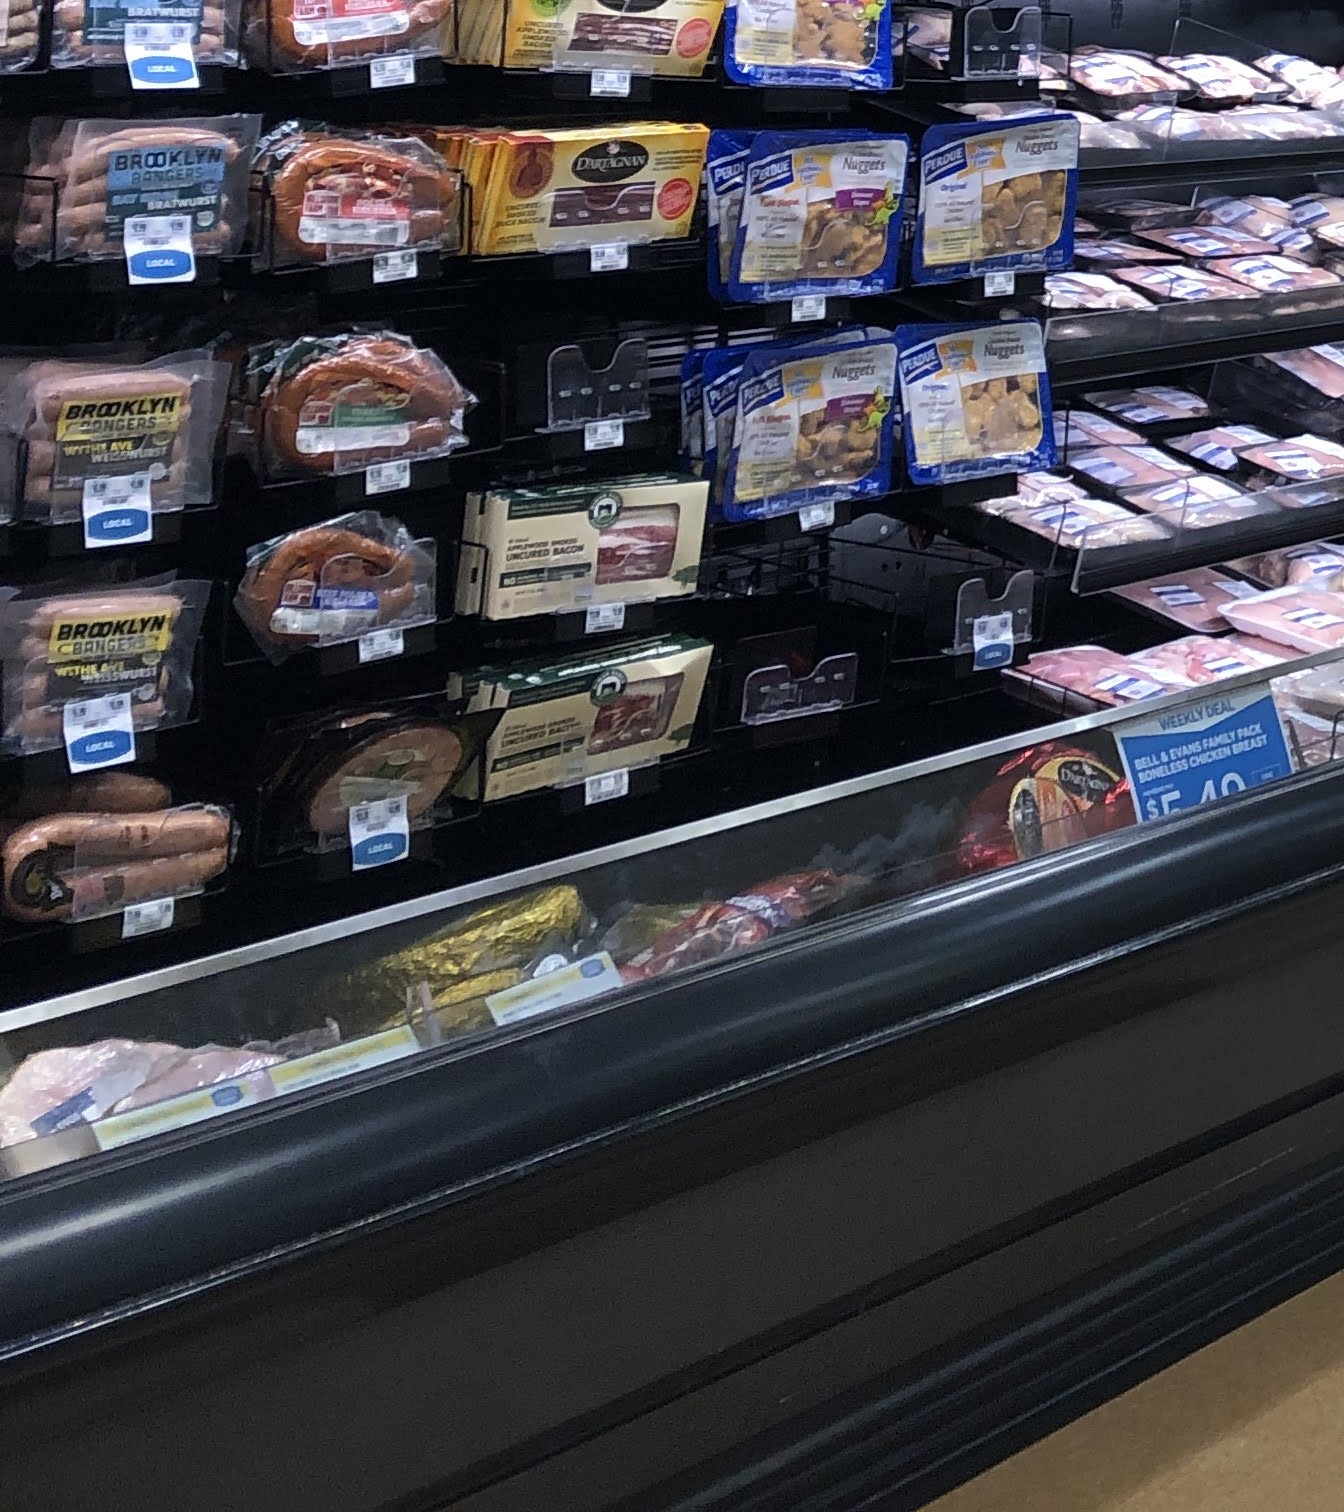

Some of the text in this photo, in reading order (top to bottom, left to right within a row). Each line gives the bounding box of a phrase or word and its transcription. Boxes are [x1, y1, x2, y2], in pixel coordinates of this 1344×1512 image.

[115, 148, 223, 171] BROOKLYN
[1015, 140, 1058, 156] Nuggets
[751, 159, 790, 181] PERDUE
[842, 157, 886, 174] Nuggets
[925, 147, 964, 173] PERDUE
[145, 259, 176, 268] LOCAL
[901, 348, 937, 372] PERDUE
[984, 343, 1024, 360] Nuggets
[832, 364, 876, 381] Nuggets
[66, 396, 177, 420] BROOKLYN
[57, 615, 167, 641] BROOKLYN
[1159, 698, 1236, 731] WEEKLY DEAL
[1134, 723, 1263, 771] BELL & EVANS FAMILY PACK
[1138, 734, 1268, 784] BONELESS CHICKEN BREAST
[367, 840, 393, 855] LOCAL
